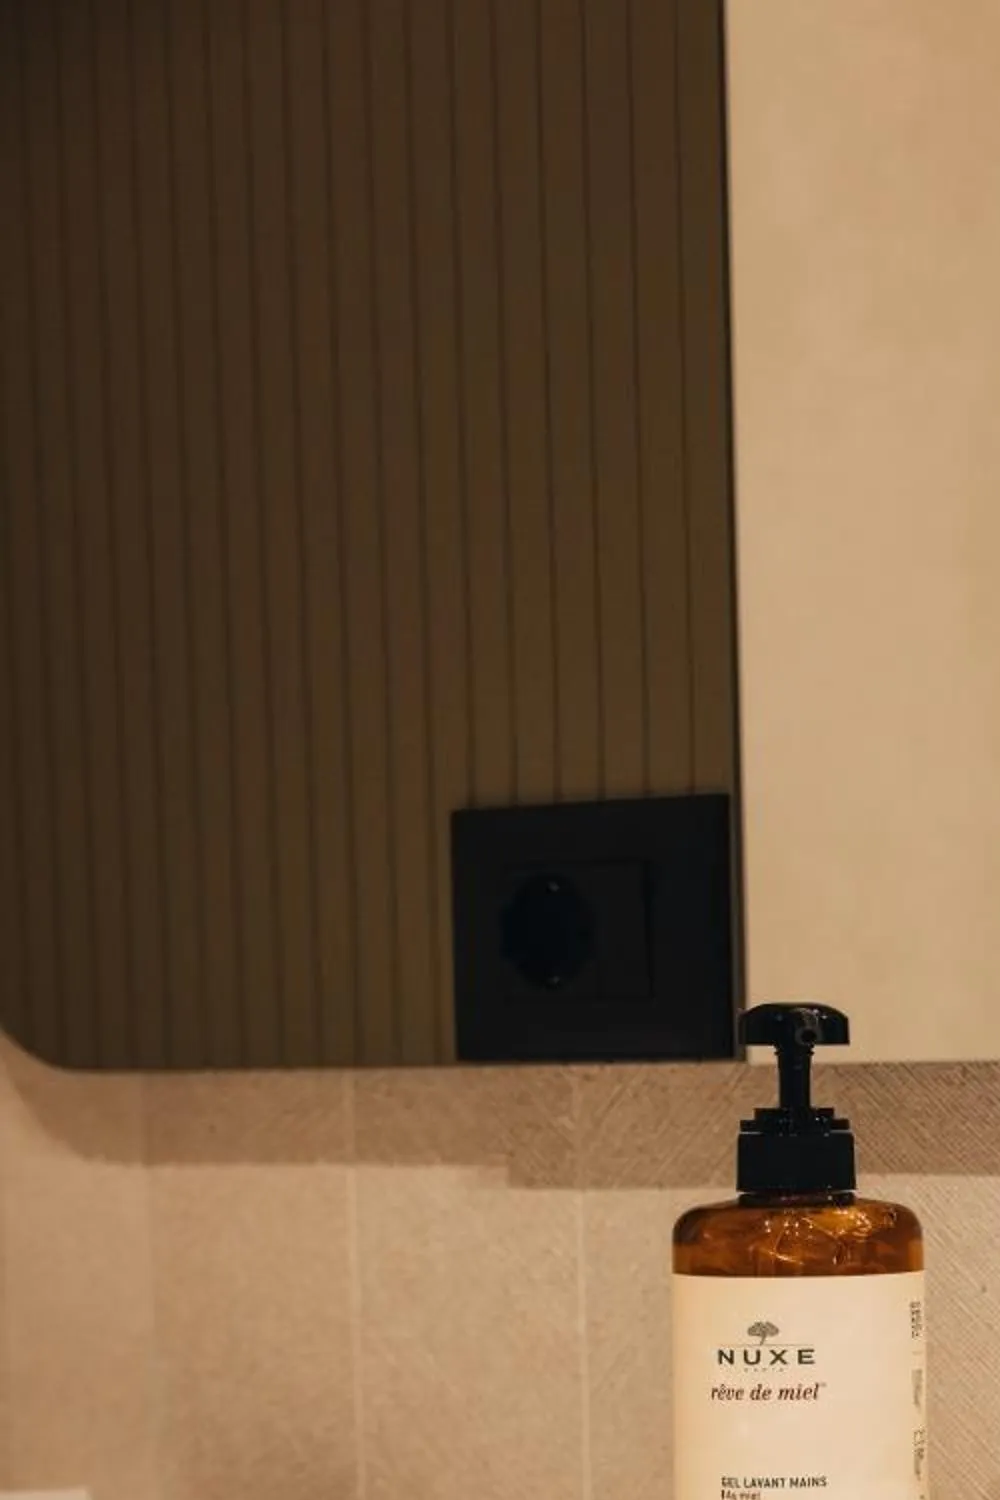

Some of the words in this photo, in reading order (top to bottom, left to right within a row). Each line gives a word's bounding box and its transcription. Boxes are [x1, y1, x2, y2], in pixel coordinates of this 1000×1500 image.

[717, 1349, 816, 1365] NUXE
[711, 1384, 745, 1401] rêve
[749, 1383, 772, 1401] de
[721, 1477, 741, 1489] GEL
[743, 1477, 786, 1489] LAVANT
[789, 1476, 828, 1488] MAINS
